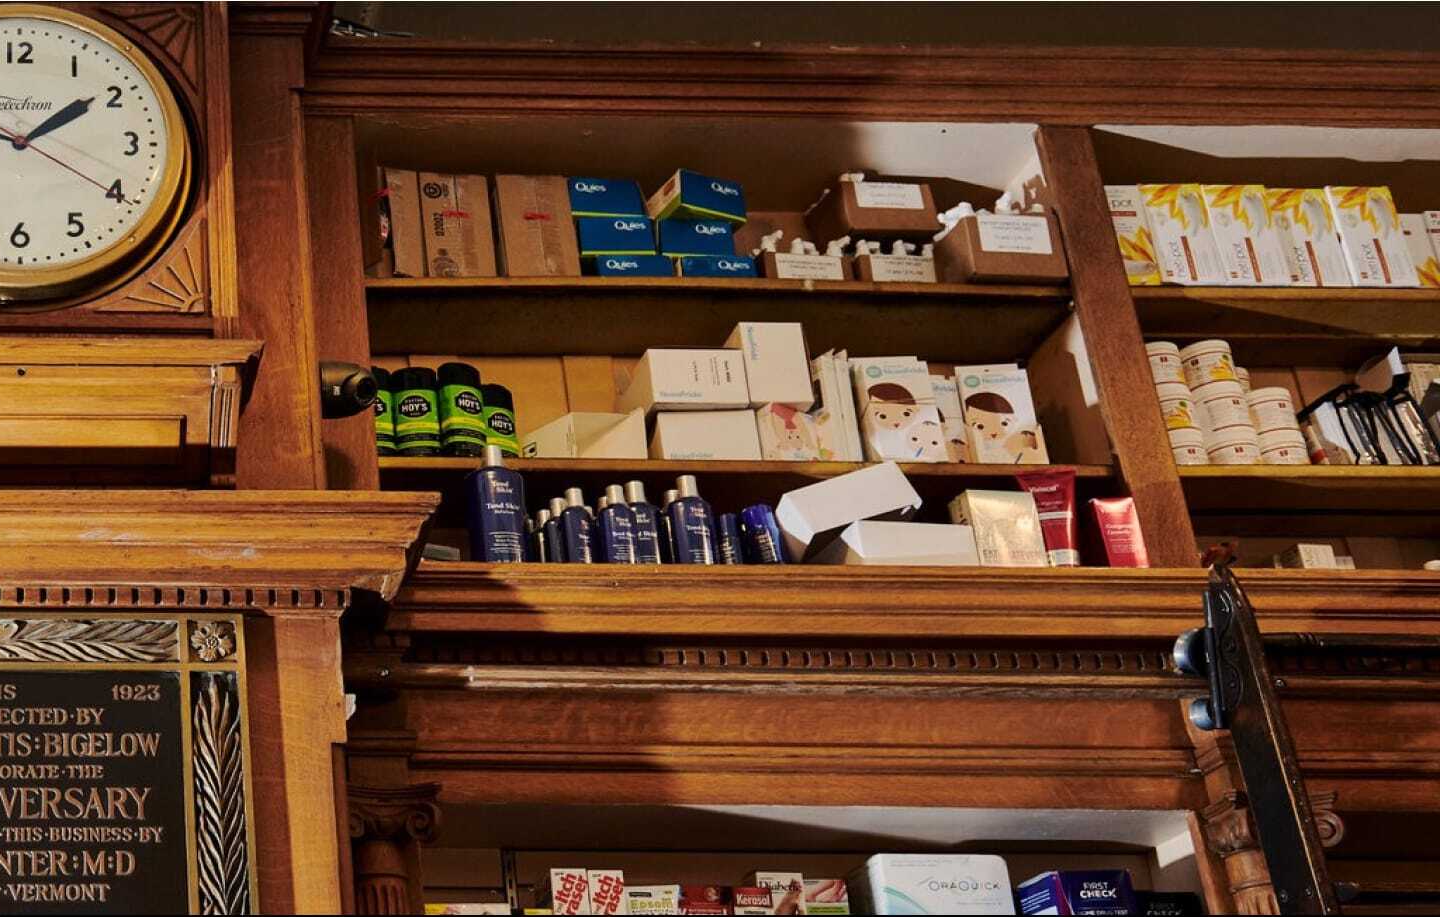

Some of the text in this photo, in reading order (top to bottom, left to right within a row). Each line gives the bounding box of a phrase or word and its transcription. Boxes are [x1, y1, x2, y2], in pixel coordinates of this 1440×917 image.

[6, 41, 33, 64] 12
[71, 55, 78, 77] 1
[106, 85, 122, 109] 2
[124, 131, 139, 156] 3
[105, 179, 124, 203] 4
[575, 182, 607, 193] Quies
[711, 182, 739, 196] Quies
[67, 212, 85, 237] 5
[614, 220, 646, 232] Quies
[695, 223, 727, 235] Quies
[10, 222, 31, 248] 6
[606, 259, 638, 271] Quies
[718, 259, 750, 271] Quies
[111, 684, 161, 700] 1923
[75, 707, 105, 726] BY
[43, 732, 161, 758] BIGELOW
[65, 764, 104, 780] THE
[2, 827, 44, 844] THIS
[49, 827, 133, 844] BUSINESS
[138, 827, 164, 844] BY
[7, 883, 112, 902] VERMONT
[555, 873, 577, 904] Itch
[566, 875, 589, 915] raser
[592, 875, 614, 906] Itch
[1079, 887, 1117, 899] CHECK
[1083, 881, 1109, 890] FIRST
